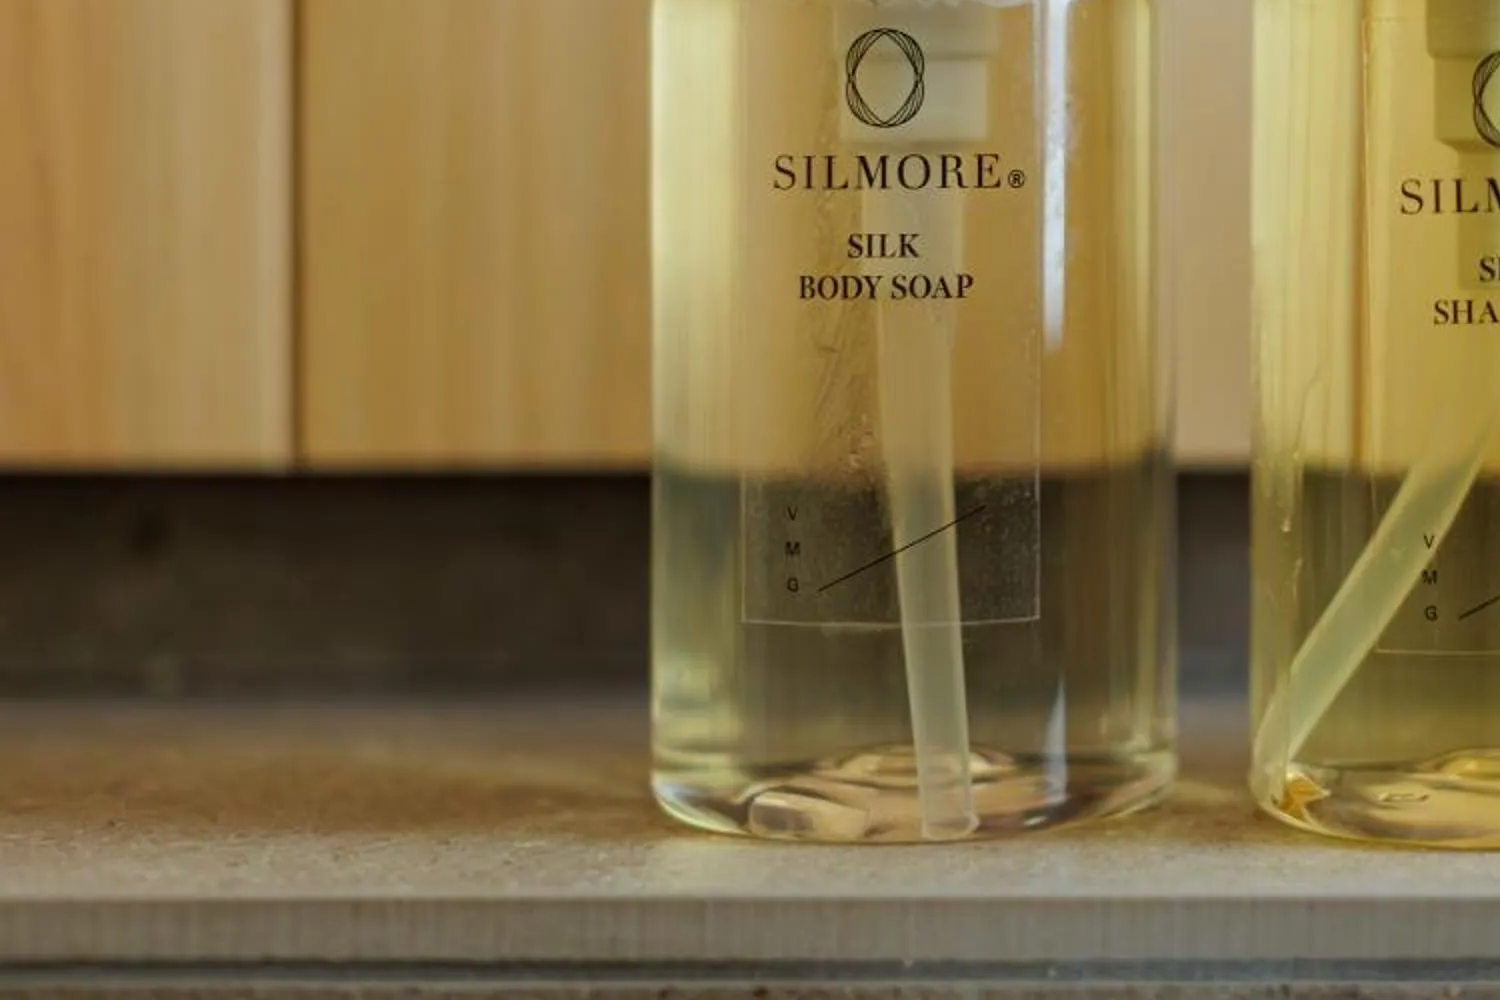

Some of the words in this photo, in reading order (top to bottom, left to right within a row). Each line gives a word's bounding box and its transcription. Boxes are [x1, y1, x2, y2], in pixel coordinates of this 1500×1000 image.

[847, 232, 920, 259] SILK
[798, 274, 883, 300] BODY
[890, 273, 975, 300] SOAP
[1423, 534, 1435, 550] V
